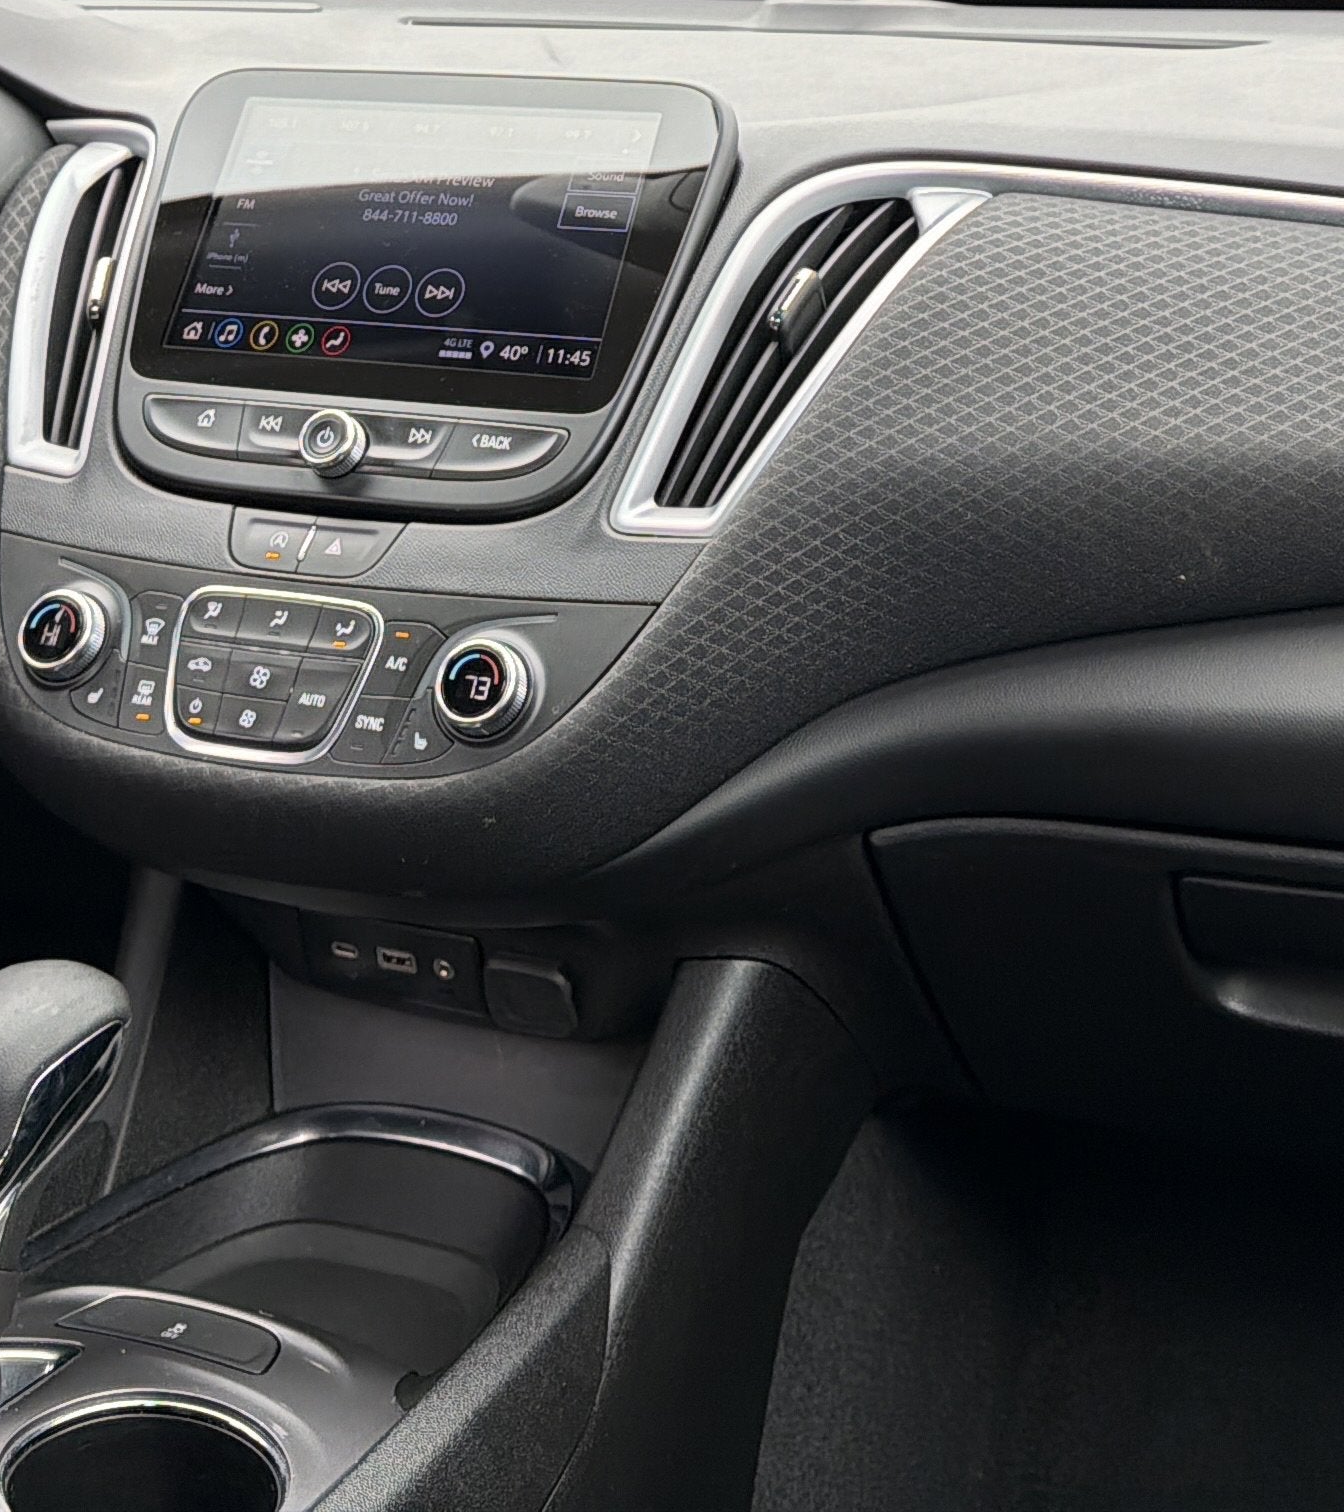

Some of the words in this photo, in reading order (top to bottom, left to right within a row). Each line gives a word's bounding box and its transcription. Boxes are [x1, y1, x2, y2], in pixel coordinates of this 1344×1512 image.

[586, 169, 625, 183] Sound
[236, 198, 256, 210] FM
[358, 188, 395, 202] Great
[398, 190, 436, 205] Offer
[438, 193, 475, 207] Now!
[362, 208, 458, 227] 844-711-8800
[574, 205, 617, 220] Browse
[194, 283, 224, 296] More
[374, 283, 400, 297] Tune
[444, 336, 457, 348] 4G
[457, 337, 473, 349] LTE
[546, 347, 591, 366] 11:45
[479, 434, 512, 450] BACK
[384, 655, 408, 673] A/C
[464, 674, 492, 702] 73
[297, 692, 327, 708] AUTO
[354, 717, 385, 733] SYNC
